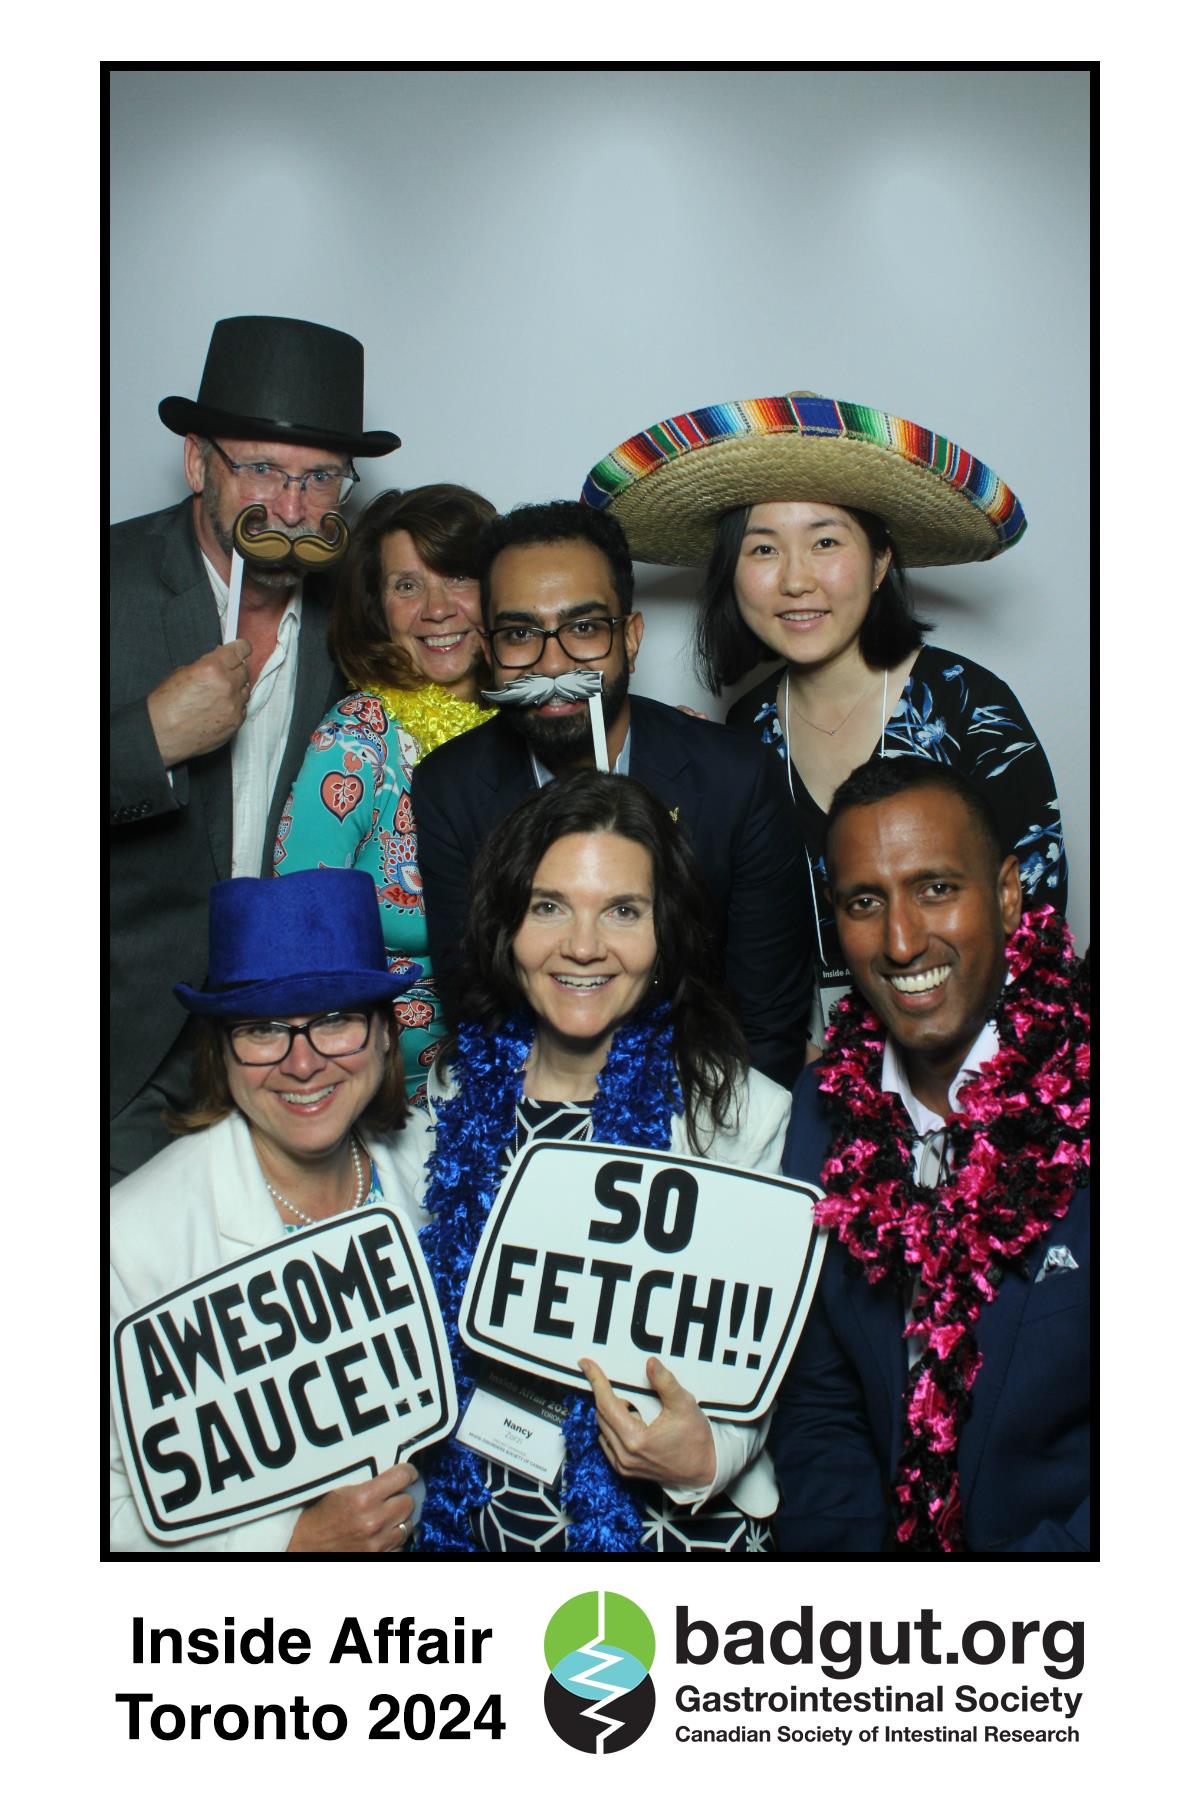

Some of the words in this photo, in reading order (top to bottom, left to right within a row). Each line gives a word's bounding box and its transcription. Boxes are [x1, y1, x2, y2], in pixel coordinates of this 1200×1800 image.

[823, 968, 844, 978] Inside
[587, 1160, 700, 1254] SO
[132, 1223, 414, 1410] AWESOME
[489, 1243, 774, 1371] FETCH!!
[142, 1324, 434, 1514] SAUCE!!
[503, 1417, 533, 1439] Nancy
[546, 1399, 571, 1417] 202
